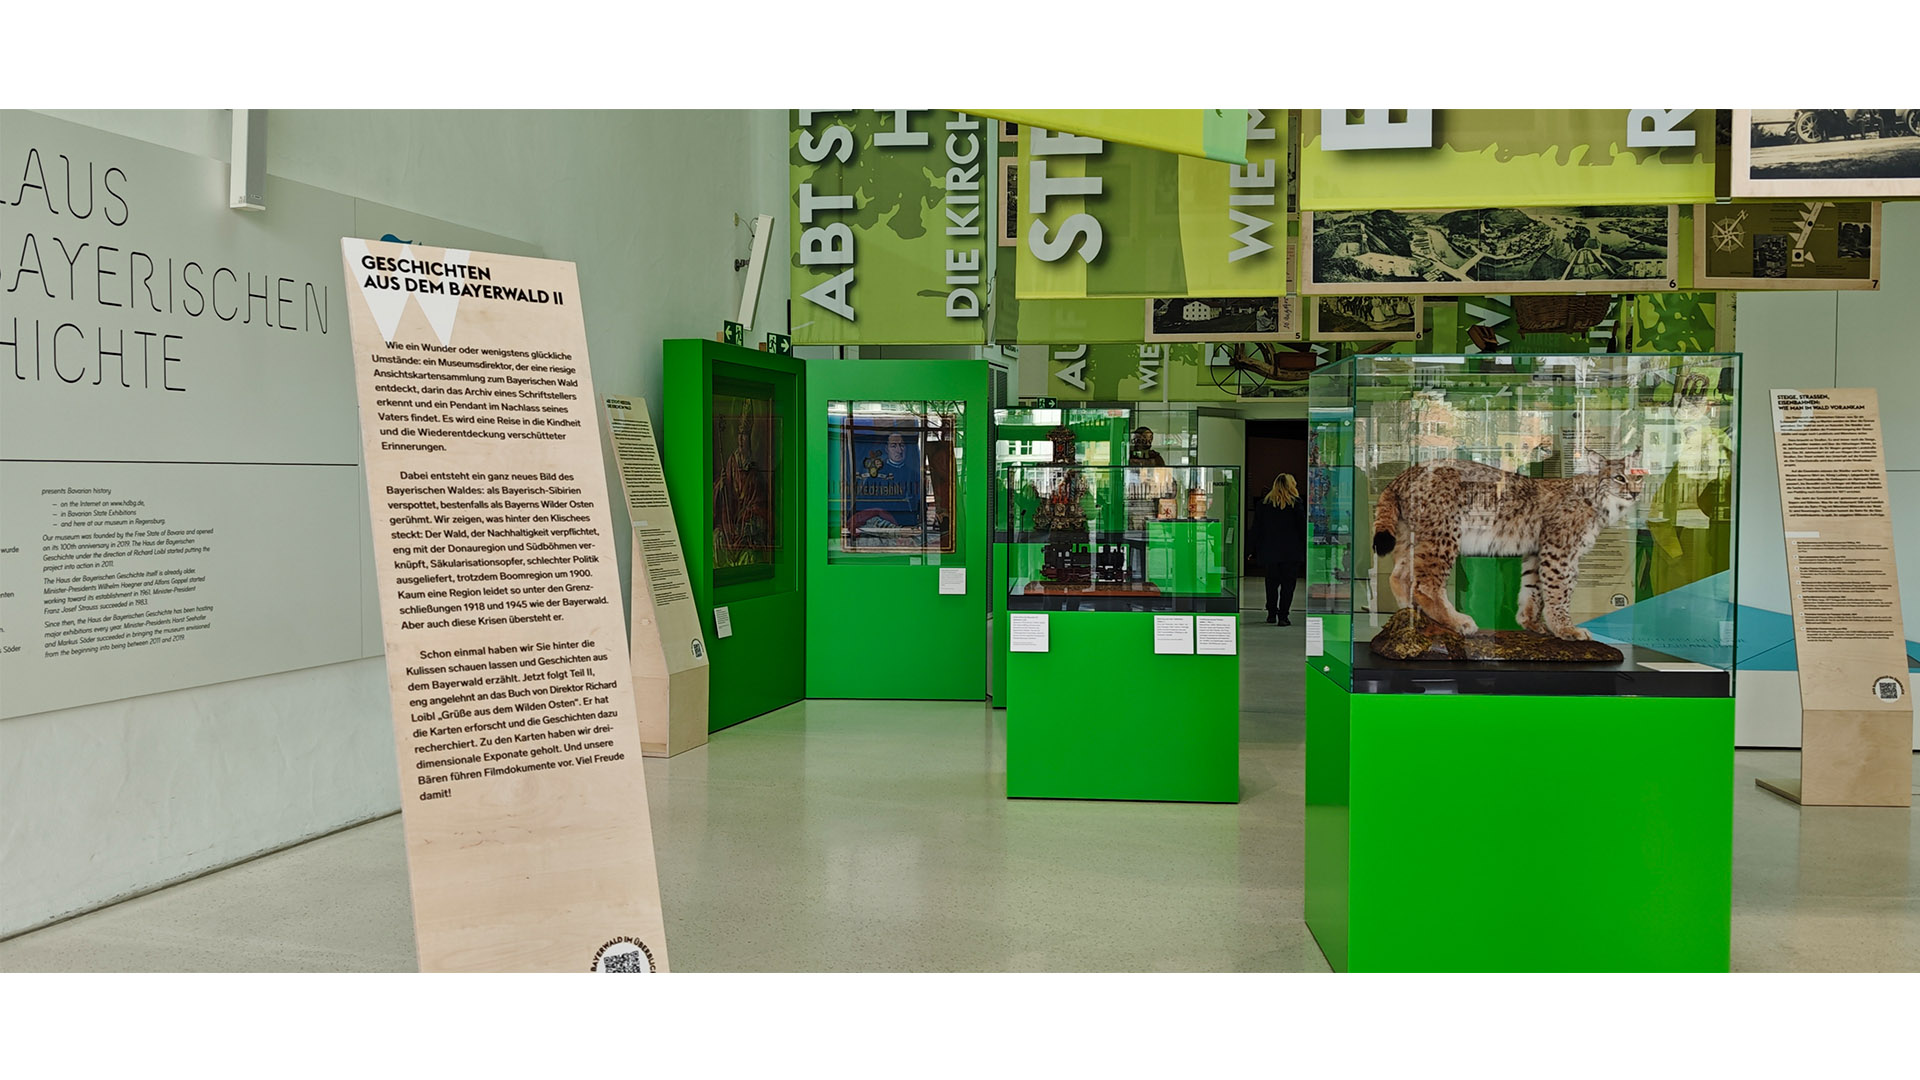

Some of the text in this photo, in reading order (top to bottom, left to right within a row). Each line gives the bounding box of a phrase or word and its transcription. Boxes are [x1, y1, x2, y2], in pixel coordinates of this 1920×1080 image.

[0, 148, 129, 227] AUS
[1228, 159, 1276, 263] WIE
[800, 183, 855, 322] ABT
[361, 255, 491, 280] GESCHICHTEN
[0, 232, 329, 335] AYERISCHEN
[363, 274, 563, 305] AUS DEM BAYERWALD II
[945, 248, 980, 318] DIE
[1669, 279, 1677, 289] 6
[1871, 279, 1879, 289] 7
[1295, 332, 1301, 340] 5
[384, 341, 572, 360] Wie ein Wunder oder wenigstens glückliche
[371, 354, 421, 365] Umstände:
[422, 357, 437, 366] ein
[437, 358, 514, 371] Museumsdirektor,
[514, 362, 529, 371] der
[530, 363, 548, 372] eine
[373, 368, 486, 384] Ansichtskartensammlung
[505, 375, 556, 386] Bayerischen
[556, 378, 578, 387] Wald
[377, 412, 581, 427] Vaters findet. Es wird eine Reise in die Kindheit
[381, 441, 447, 453] Erinnerungen.
[385, 485, 581, 496] Bayerischen Waldes: als Bayerisch-Sibirien
[387, 500, 594, 511] verspottet, bestenfalls als Bayerns Wilder Osten
[390, 527, 600, 539] steckt: Der Wald, der Nachhaltigkeit verpflichtet,
[396, 573, 455, 585] ausgeliefert,
[456, 572, 498, 582] trotzdem
[499, 570, 553, 581] Boomregion
[569, 569, 593, 577] 1900.
[399, 596, 609, 615] schließungen 1918 und 1945 wie der Bayerwald.
[405, 666, 446, 676] Kulissen
[448, 663, 487, 673] schauen
[488, 660, 518, 669] lassen
[519, 657, 536, 667] und
[537, 654, 591, 666] Geschichten
[410, 695, 609, 722] Loibl „Grüße aus dem Wilden Osten“. Er hat
[417, 752, 624, 785] Bären führen Filmdokumente vor. Viel Freude
[419, 788, 451, 801] damit!
[633, 936, 656, 973] ÜBERBLIC
